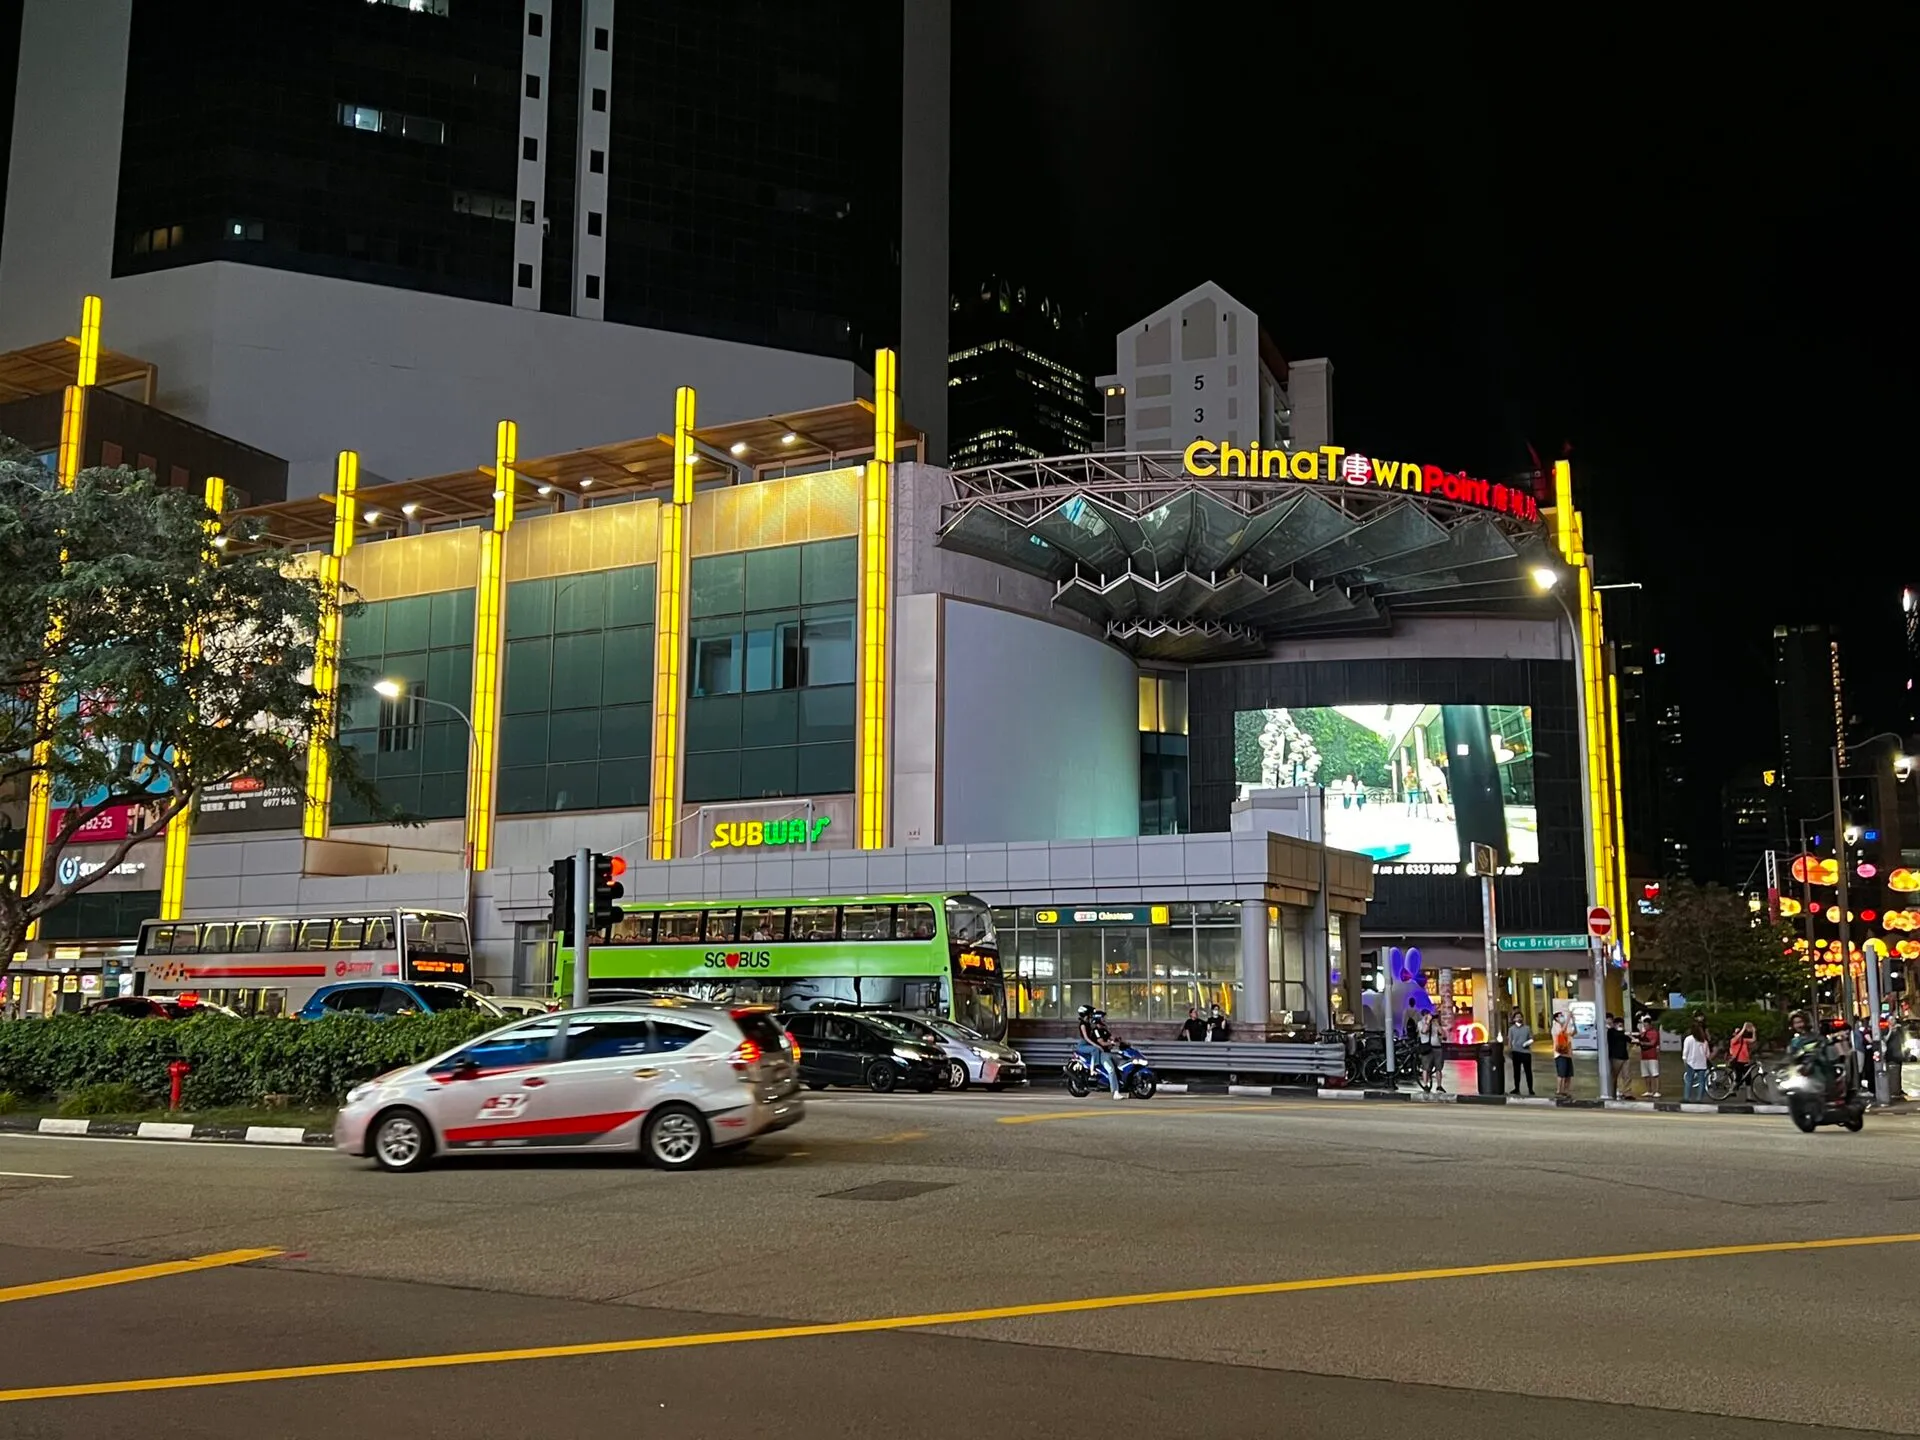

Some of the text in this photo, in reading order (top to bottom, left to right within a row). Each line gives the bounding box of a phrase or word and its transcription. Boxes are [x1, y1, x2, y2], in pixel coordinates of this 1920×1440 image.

[1422, 464, 1490, 507] Point
[710, 815, 831, 849] SUBWAY
[1504, 937, 1585, 950] New Bridge Rd
